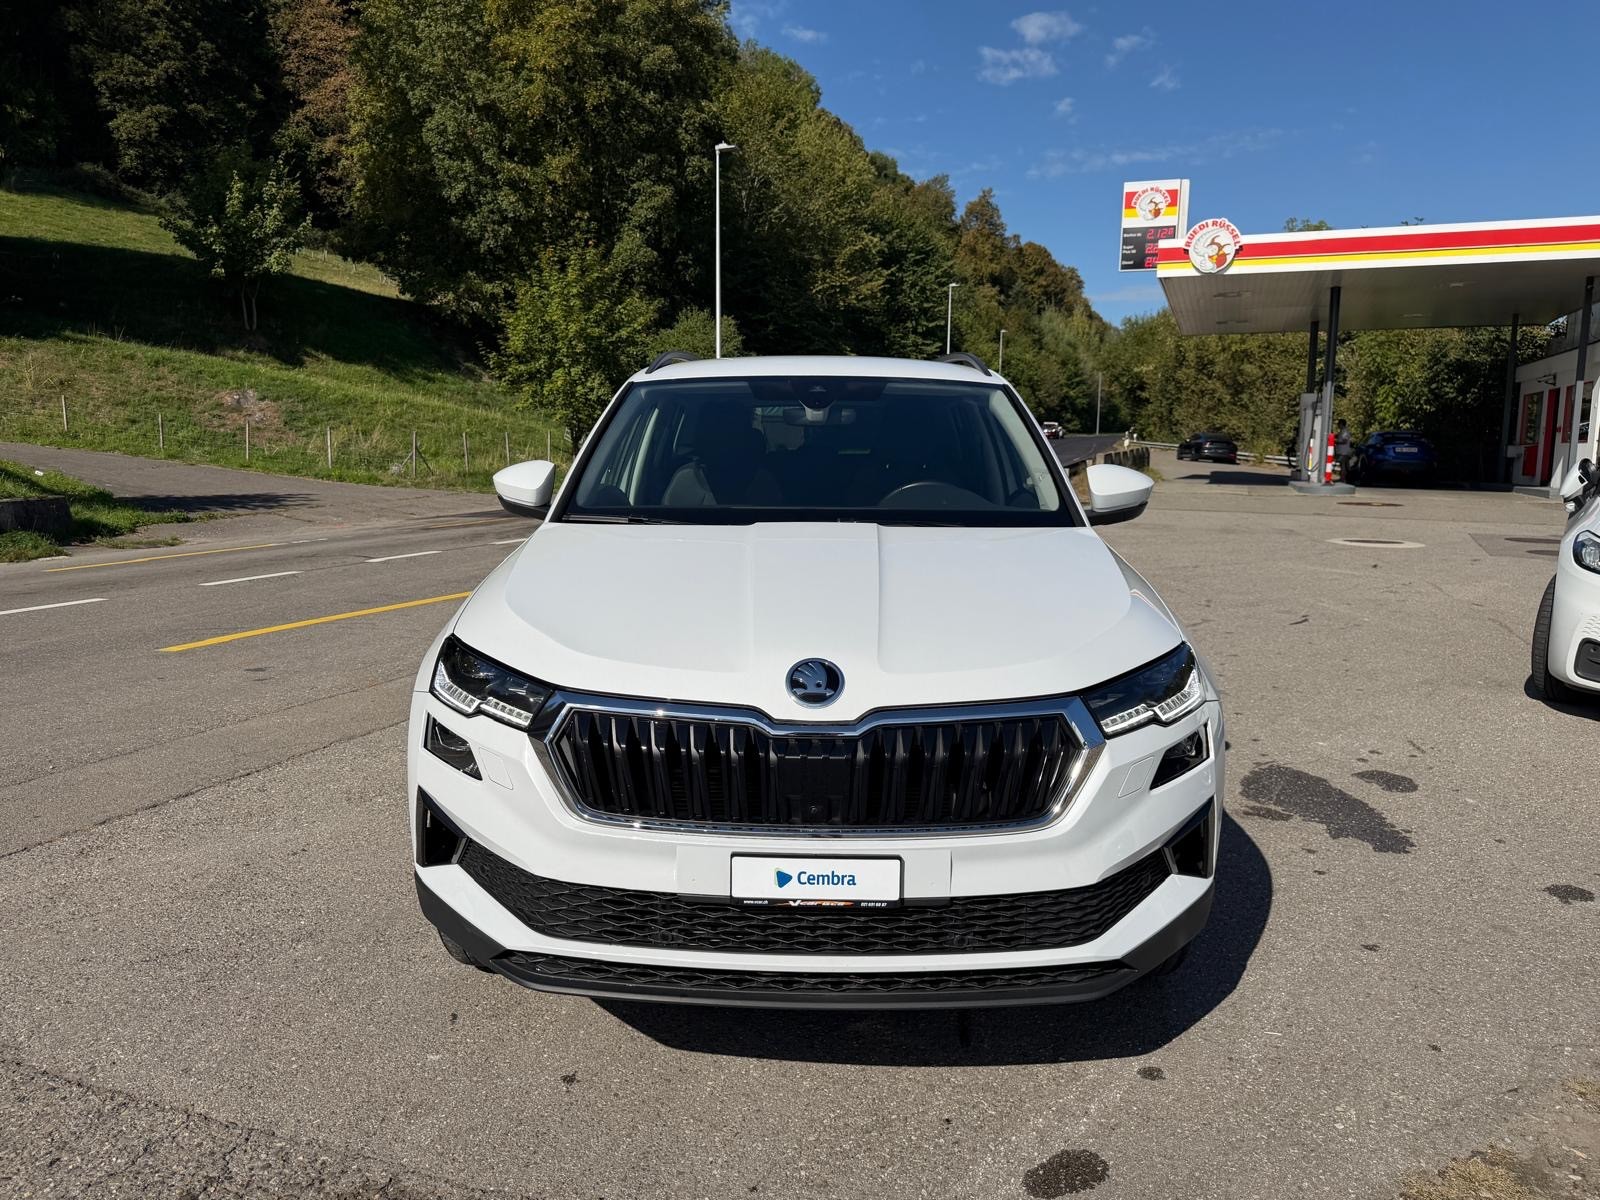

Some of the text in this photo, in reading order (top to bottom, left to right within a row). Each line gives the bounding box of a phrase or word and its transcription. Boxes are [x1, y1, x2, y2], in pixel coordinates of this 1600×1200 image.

[1184, 219, 1241, 248] RUEDI RÜSSEL
[797, 870, 857, 886] Cembra
